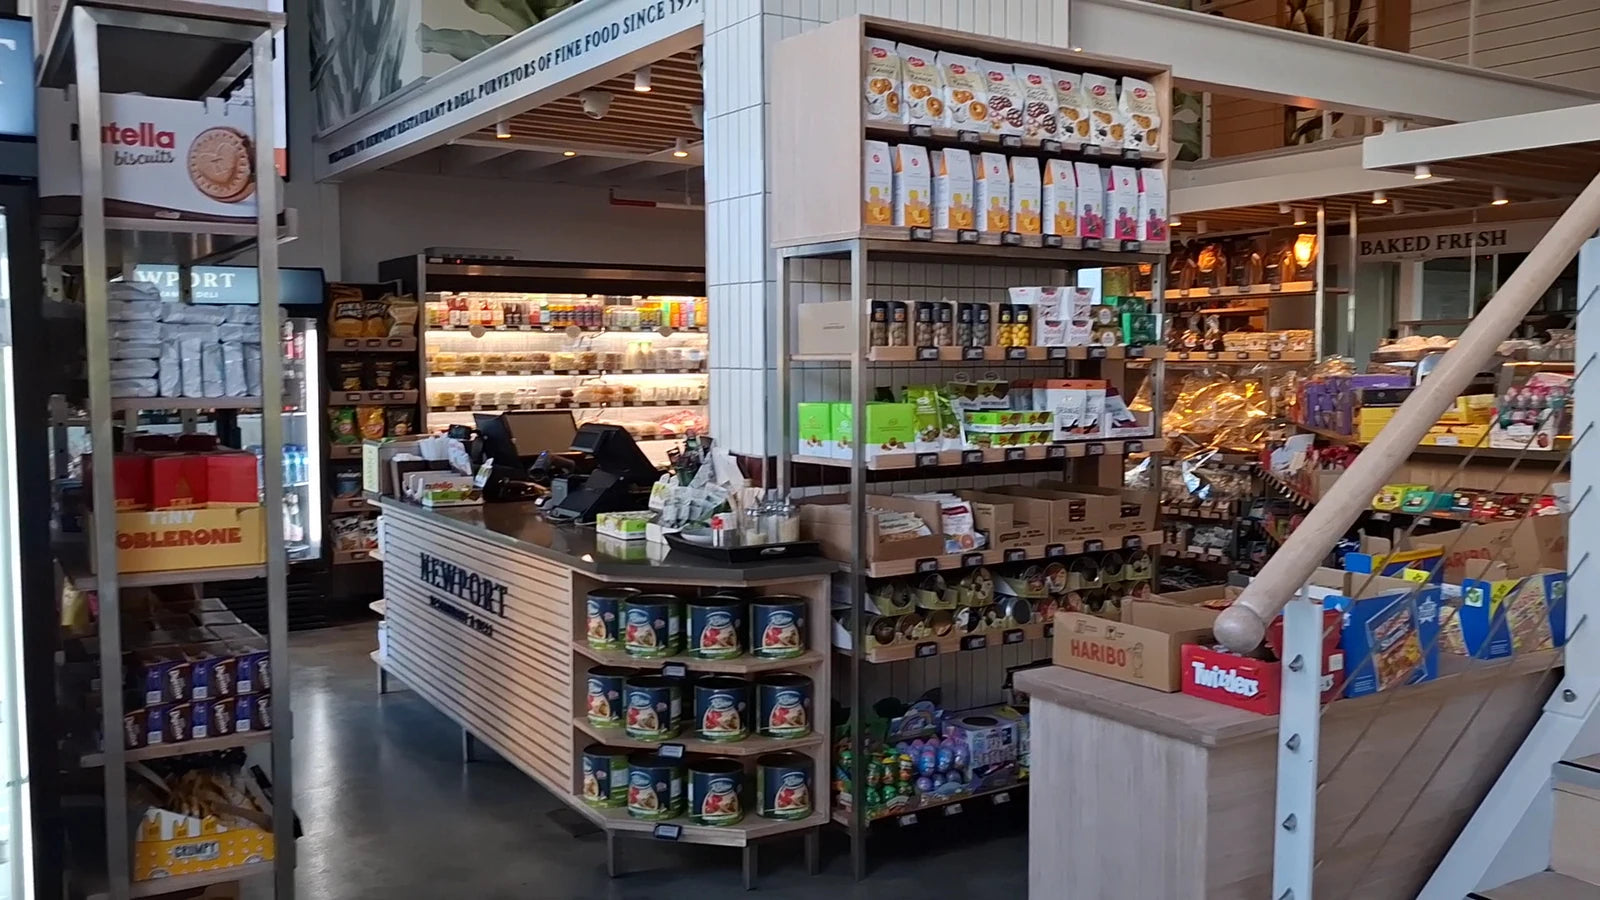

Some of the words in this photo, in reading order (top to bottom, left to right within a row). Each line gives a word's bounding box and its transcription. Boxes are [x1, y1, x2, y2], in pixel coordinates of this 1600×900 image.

[478, 60, 536, 99] PURVEYORS
[537, 52, 552, 72] OF
[555, 38, 583, 65] FINE
[584, 22, 620, 52] FOOD
[622, 1, 666, 34] SINCE
[113, 150, 174, 166] biscuits
[1360, 235, 1430, 256] BAKED
[1436, 229, 1507, 251] FRESH
[116, 527, 242, 550] OBLERONE
[419, 552, 508, 619] NEWPORT
[1071, 638, 1127, 668] HARIBO
